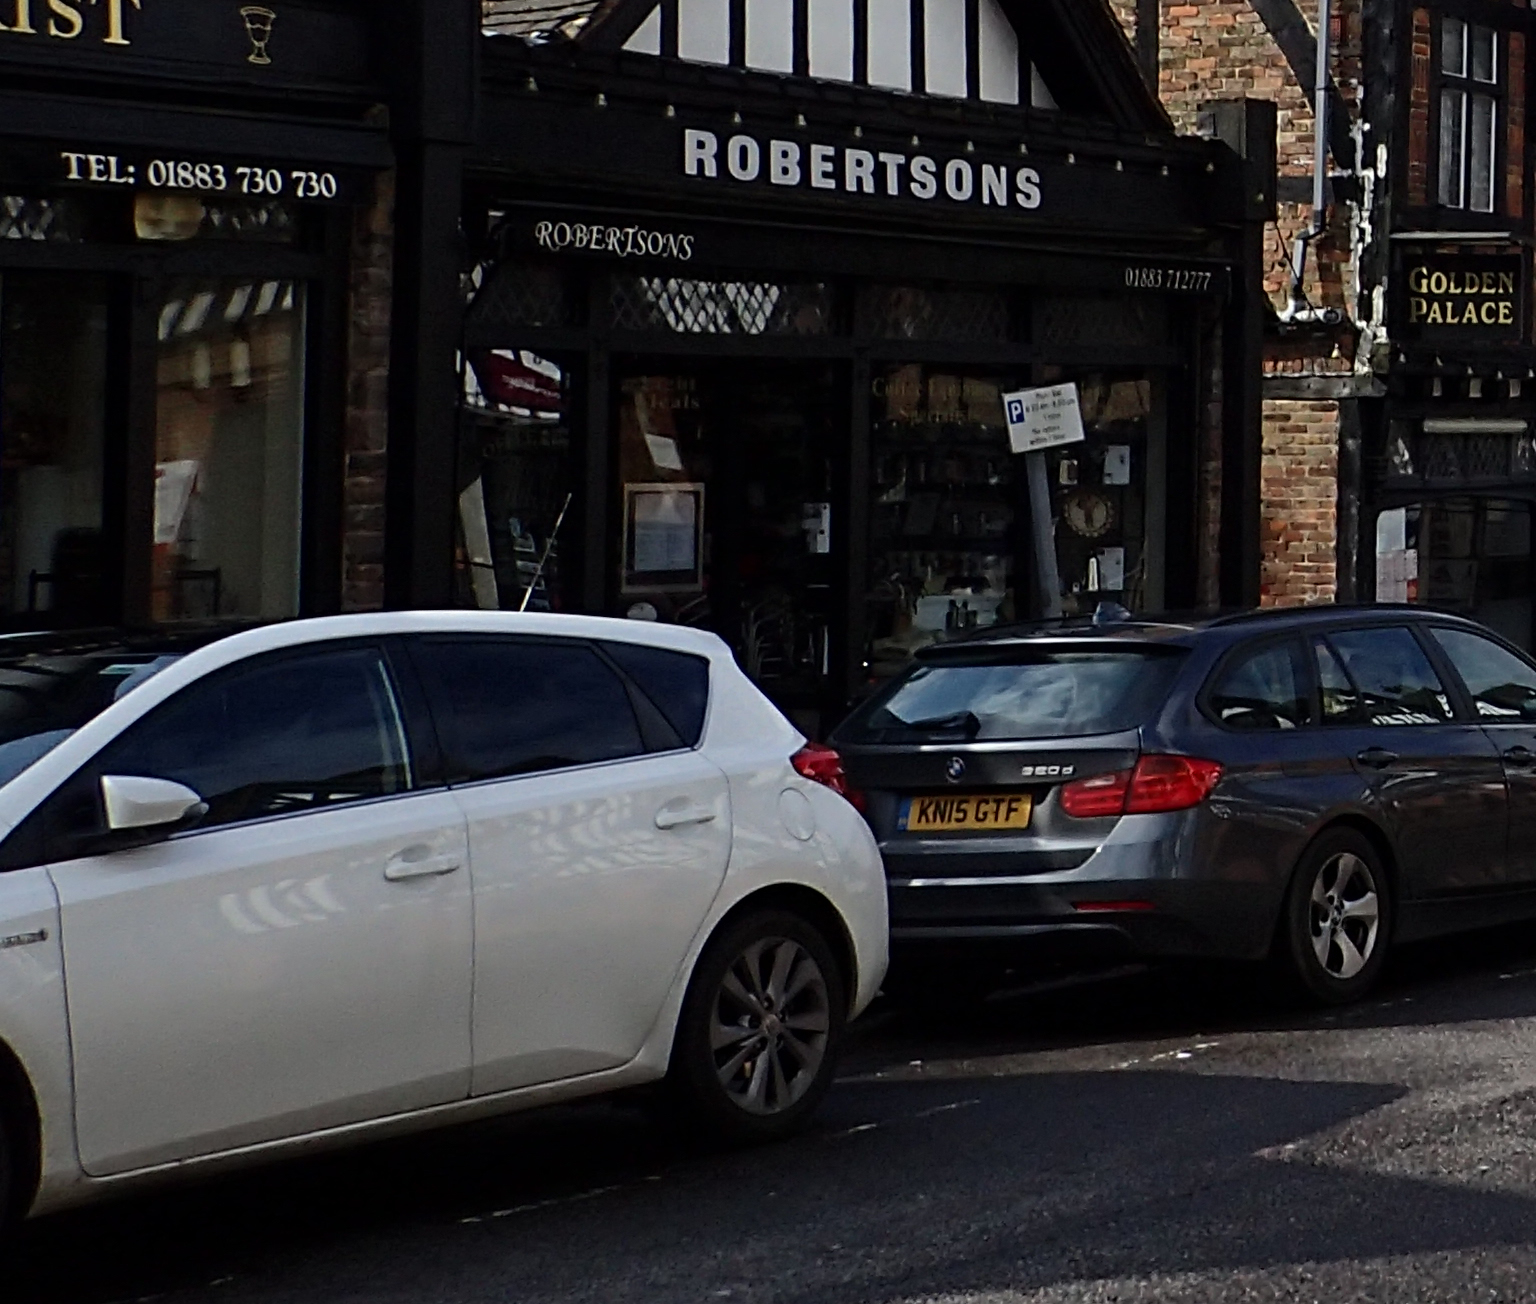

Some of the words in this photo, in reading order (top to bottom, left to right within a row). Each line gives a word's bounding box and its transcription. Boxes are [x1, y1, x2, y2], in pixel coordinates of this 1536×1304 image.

[60, 151, 136, 184] TEL:
[147, 159, 227, 190] 01883
[234, 166, 283, 194] 730
[290, 171, 338, 198] 730
[684, 128, 1043, 209] ROBERTSONS
[534, 220, 695, 261] ROBERTSONS
[1124, 267, 1162, 289] 01883
[1166, 270, 1212, 292] 712777
[1408, 265, 1515, 294] GOLDEN
[1408, 297, 1514, 325] PALACE
[916, 797, 969, 824] KN15
[973, 796, 1022, 823] GTF
